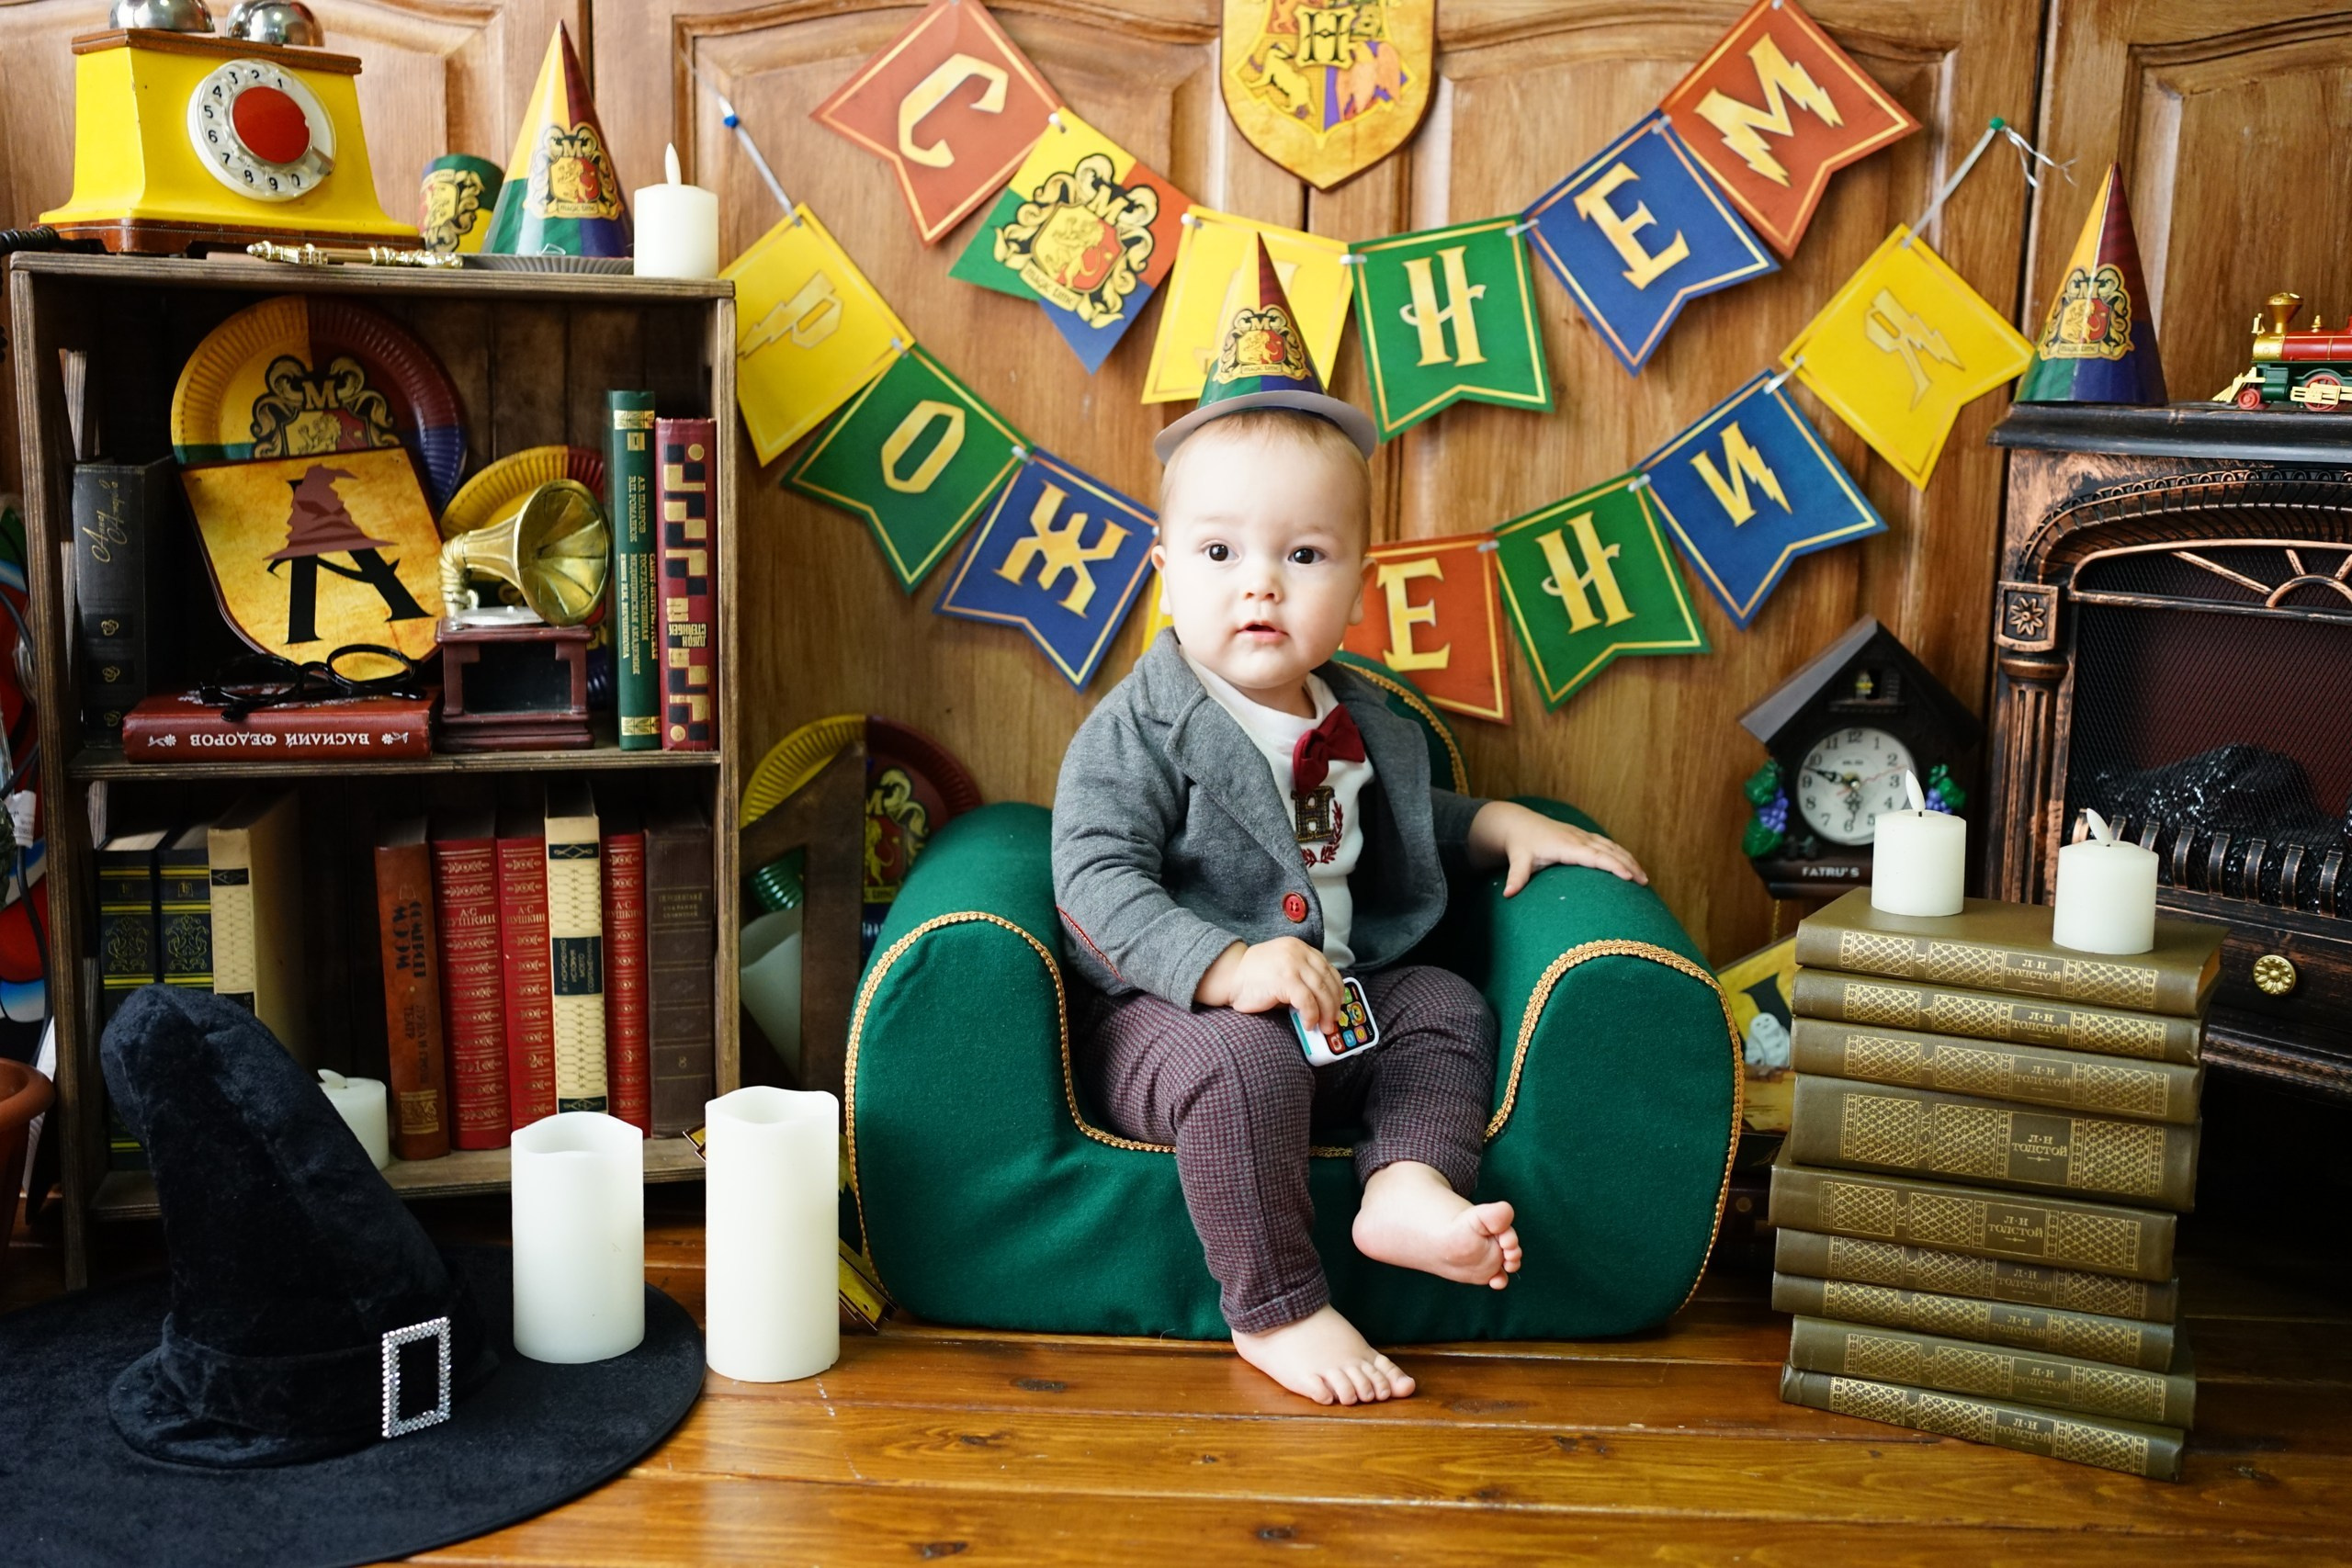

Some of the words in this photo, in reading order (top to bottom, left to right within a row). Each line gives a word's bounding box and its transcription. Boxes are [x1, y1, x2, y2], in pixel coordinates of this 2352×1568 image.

[1304, 11, 1346, 62] H
[277, 78, 283, 89] 1
[212, 85, 222, 98] 4
[204, 105, 214, 118] 5
[208, 130, 218, 143] 6
[562, 139, 583, 157] M
[222, 152, 231, 164] 7
[244, 170, 254, 183] 8
[269, 177, 278, 191] 9
[1087, 184, 1130, 227] M
[1250, 317, 1271, 331] M
[301, 379, 339, 410] M
[190, 732, 277, 748] ФЕДОРОВ
[285, 732, 370, 749] ВАСИЛИЙ
[1848, 729, 1863, 744] 12
[1826, 738, 1838, 750] 11
[1887, 753, 1898, 766] 2
[1803, 775, 1813, 788] 9
[1890, 775, 1900, 788] 3
[1806, 796, 1816, 810] 8
[1884, 796, 1893, 809] 4
[1821, 813, 1830, 826] 7
[1844, 820, 1854, 832] 6
[442, 914, 496, 928] ПУШКИН
[506, 913, 546, 924] ПУШКИН
[605, 909, 641, 919] ПУШКИН
[2006, 966, 2063, 982] ТОЛСТОЙ
[2012, 1019, 2069, 1035] ТОЛСТОЙ
[2014, 1074, 2071, 1088] ТОЛСТОЙ
[2012, 1142, 2068, 1157] ТОЛСТОЙ
[1987, 1223, 2043, 1238] ТОЛСТОЙ
[1996, 1277, 2052, 1292] ТОЛСТОЙ
[1991, 1323, 2046, 1338] ТОЛСТОЙ
[2014, 1375, 2070, 1390] ТОЛСТОЙ
[1996, 1426, 2052, 1443] ТОЛСТОЙ
